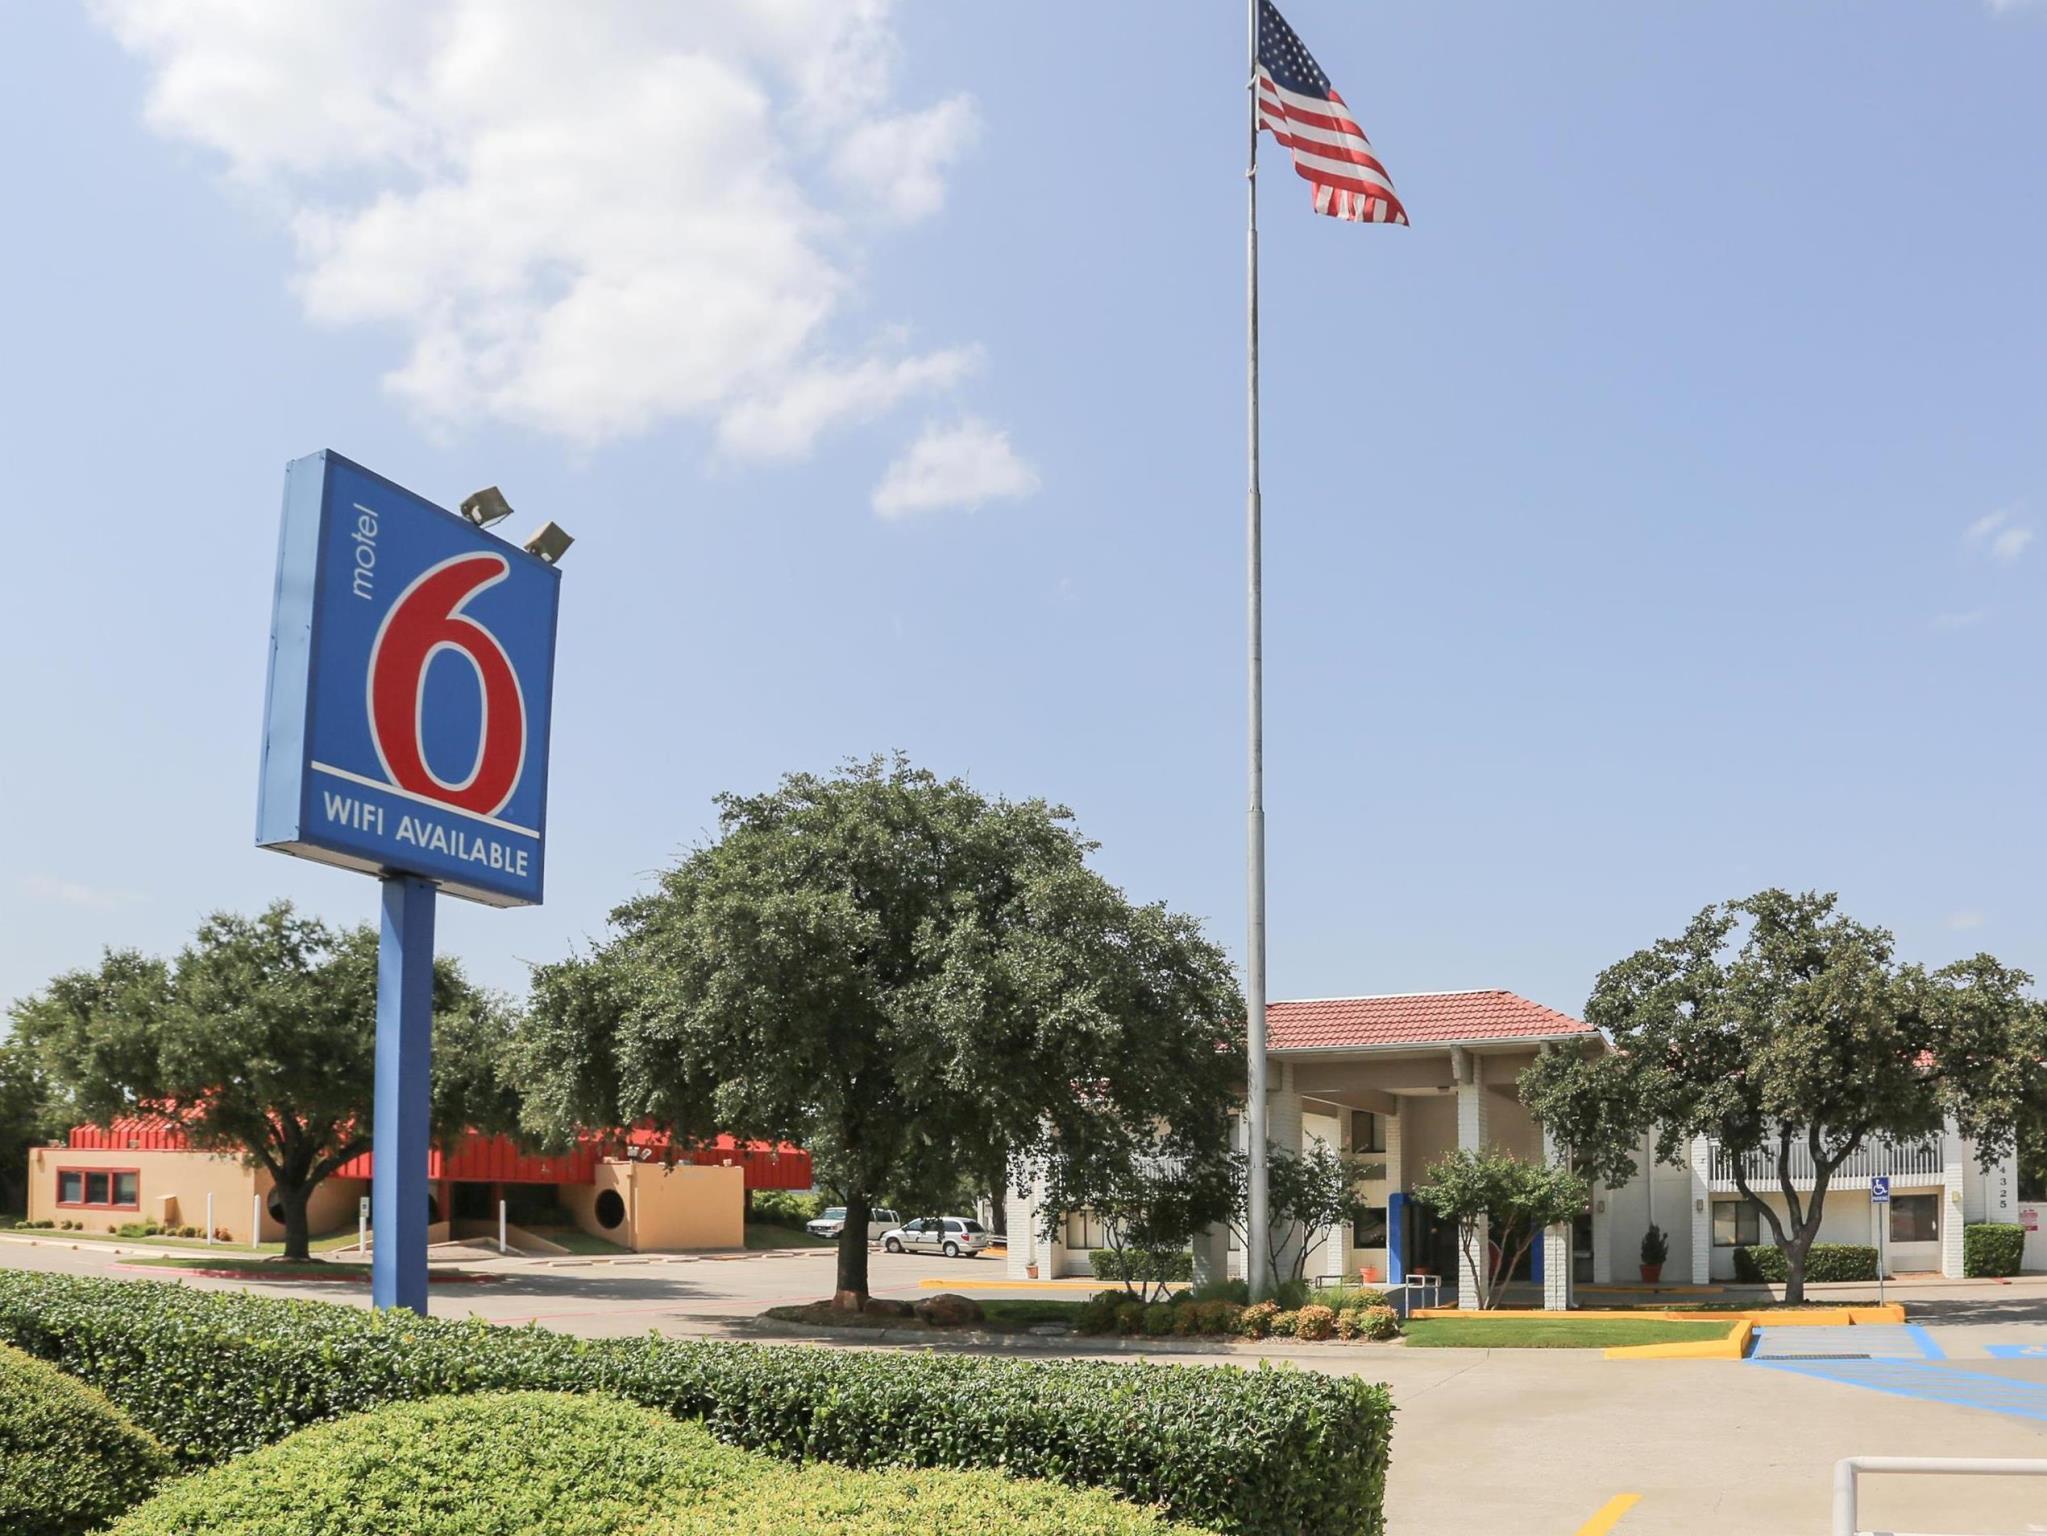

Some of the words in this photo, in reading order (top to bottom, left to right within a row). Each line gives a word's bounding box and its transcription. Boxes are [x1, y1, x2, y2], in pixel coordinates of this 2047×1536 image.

[351, 502, 378, 600] motel
[366, 550, 528, 816] 6
[323, 790, 384, 836] WIFI
[395, 815, 529, 877] AVAILABLE
